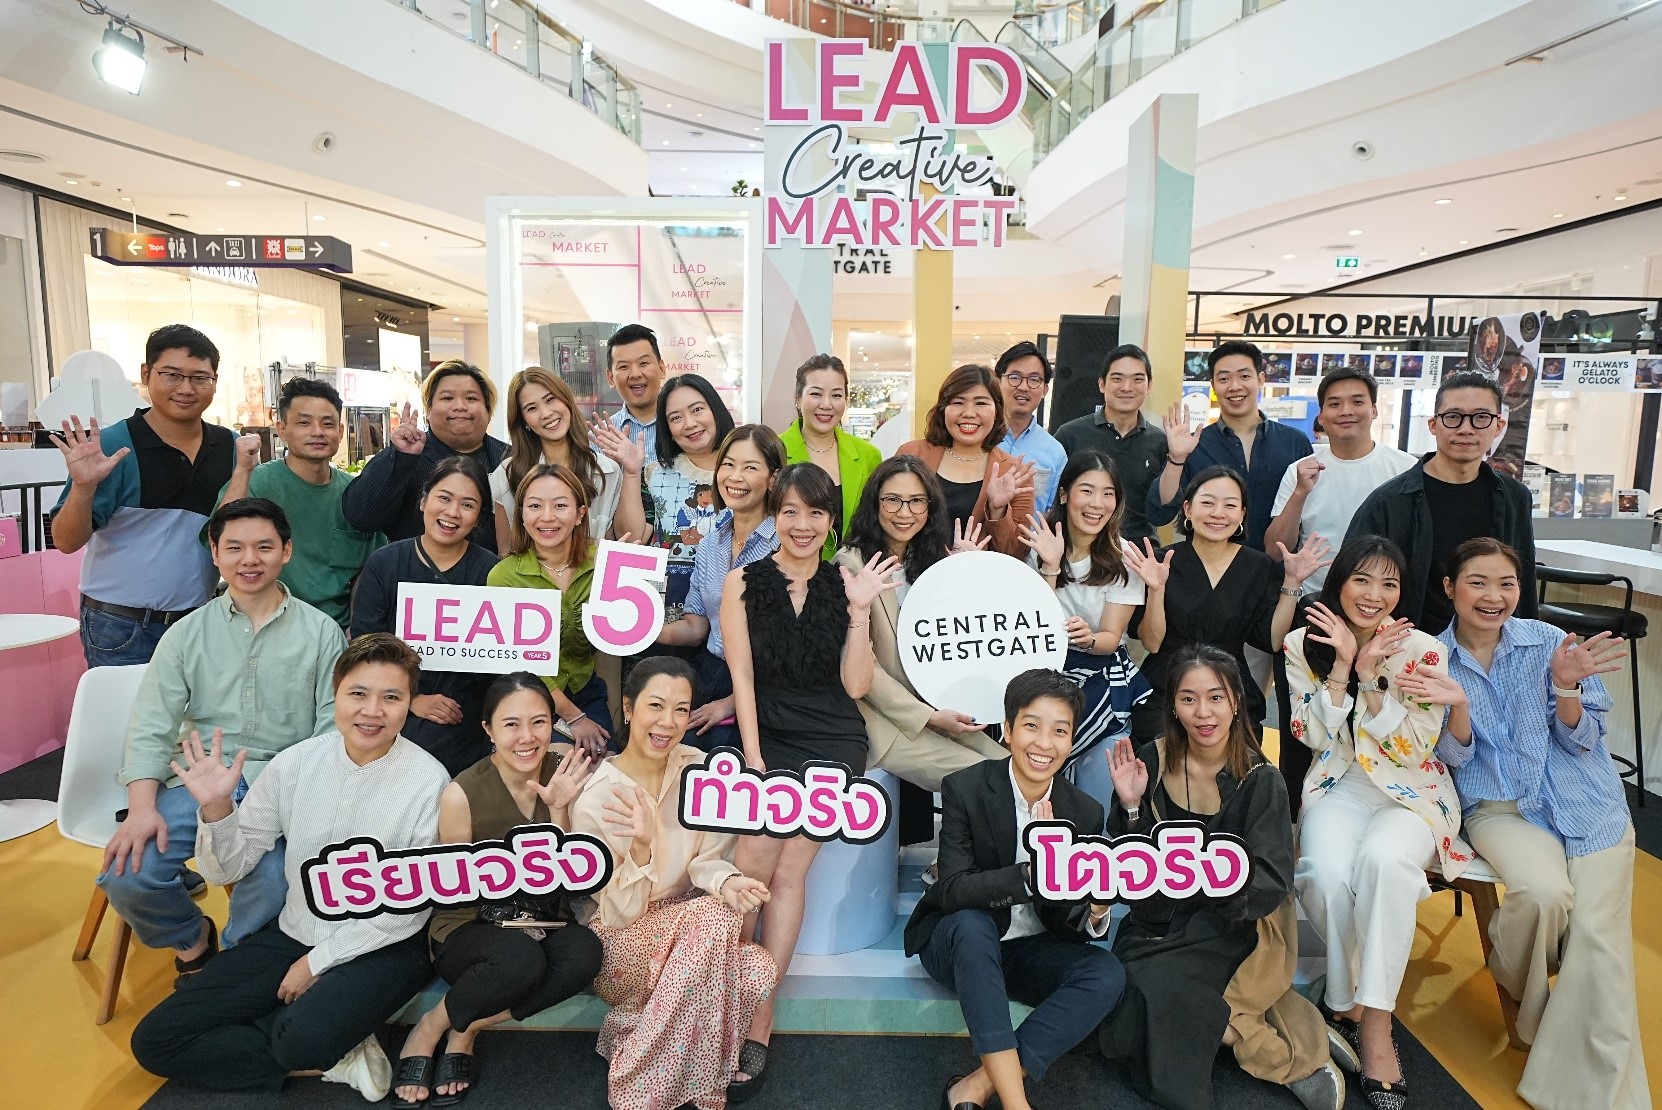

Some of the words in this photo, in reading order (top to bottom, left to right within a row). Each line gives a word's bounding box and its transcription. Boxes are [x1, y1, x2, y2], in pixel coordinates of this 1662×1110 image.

[769, 42, 1022, 125] LEAD
[783, 123, 992, 202] Creative
[768, 197, 1015, 248] MARKET
[93, 232, 102, 257] 1
[552, 241, 609, 253] MARKET
[837, 242, 889, 257] TRAL
[672, 263, 706, 274] LEAD
[833, 260, 892, 274] TGATE
[671, 290, 711, 299] MARKET
[1244, 312, 1348, 336] MOLTO
[1356, 313, 1472, 338] PREMIU
[1572, 360, 1590, 368] IT'S
[1591, 360, 1629, 369] ALWAYS
[1581, 368, 1618, 377] GELATO
[1578, 376, 1621, 385] O'CLOCK
[592, 550, 657, 646] 5
[403, 597, 553, 646] LEAD
[914, 610, 1050, 638] CENTRAL
[439, 646, 456, 657] TO
[461, 647, 518, 660] SUCCESS
[541, 652, 548, 660] 5
[912, 633, 1057, 663] WESTGATE
[690, 759, 879, 832] ทำจริง
[318, 837, 598, 909] เรียนจริง
[1037, 834, 1241, 892] โตจริง
